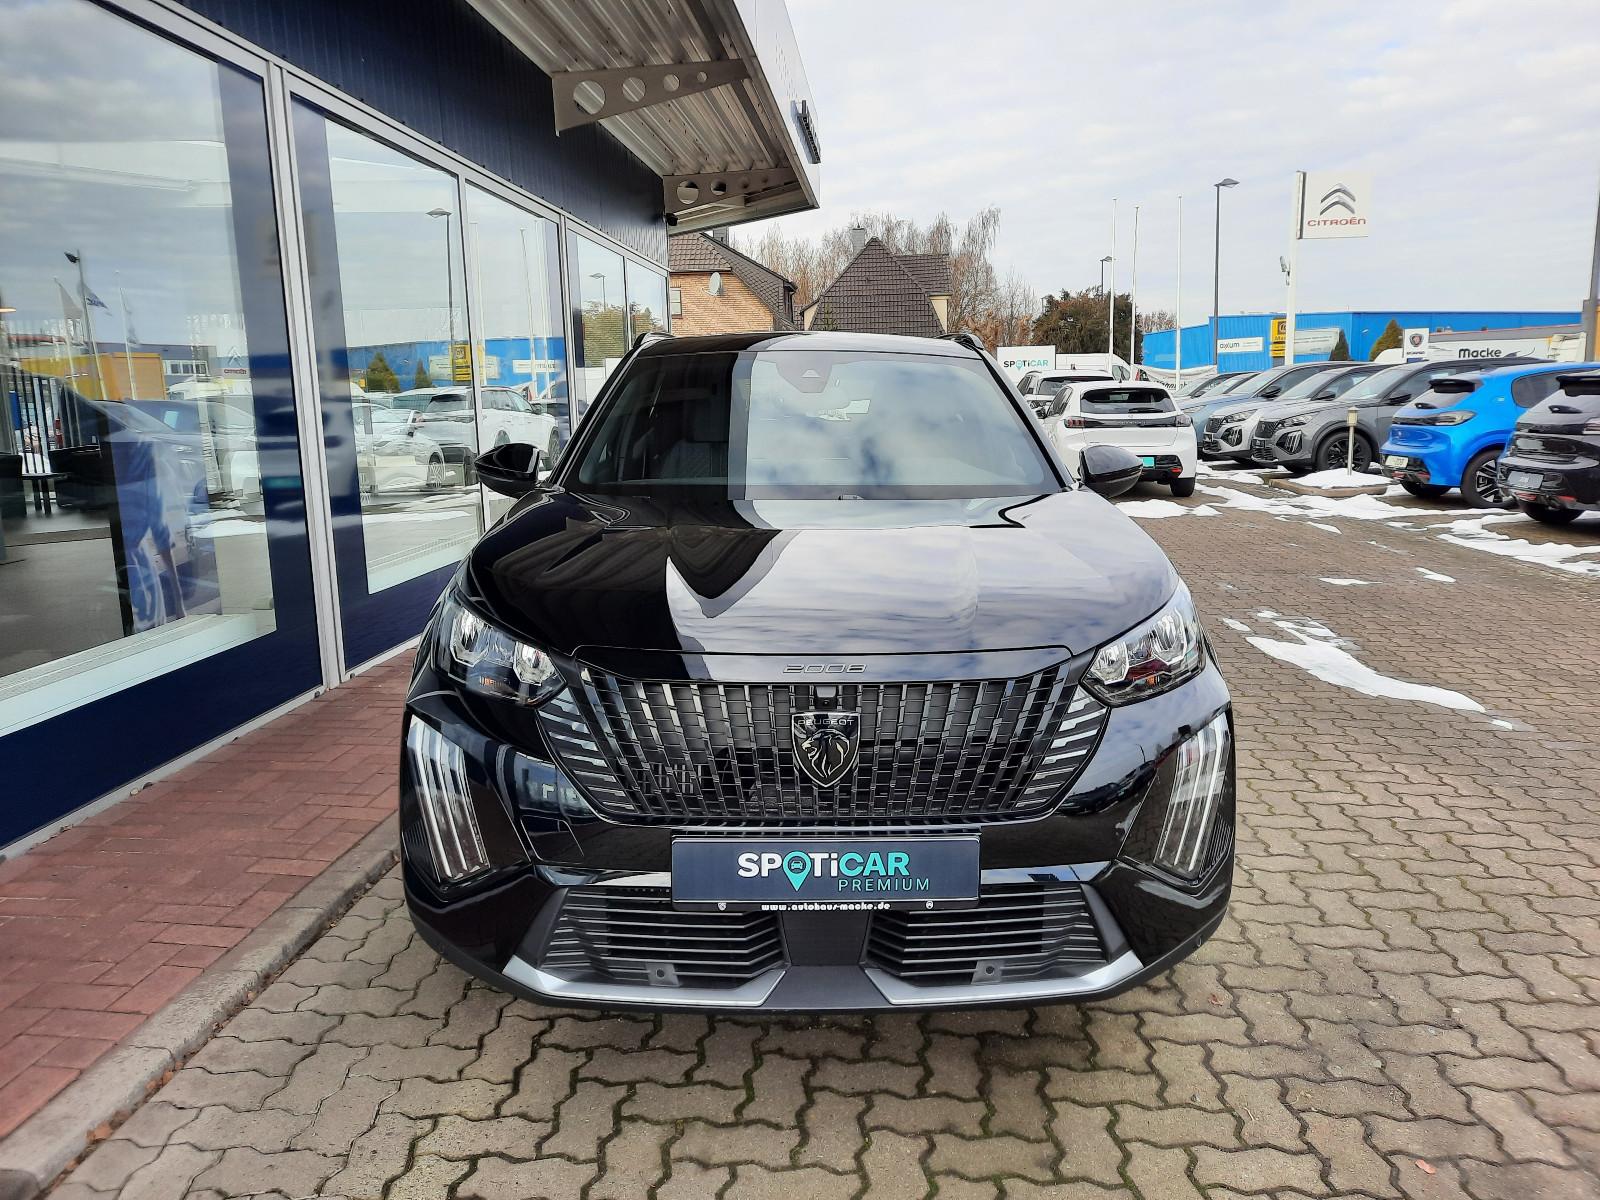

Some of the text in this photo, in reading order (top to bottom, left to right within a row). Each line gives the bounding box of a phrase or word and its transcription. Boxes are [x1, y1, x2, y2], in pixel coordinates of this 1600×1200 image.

[783, 663, 867, 674] 2008
[797, 718, 855, 727] PEUGEOT
[838, 877, 930, 892] PREMIUM
[761, 901, 891, 911] www.autohaus-macke.de
